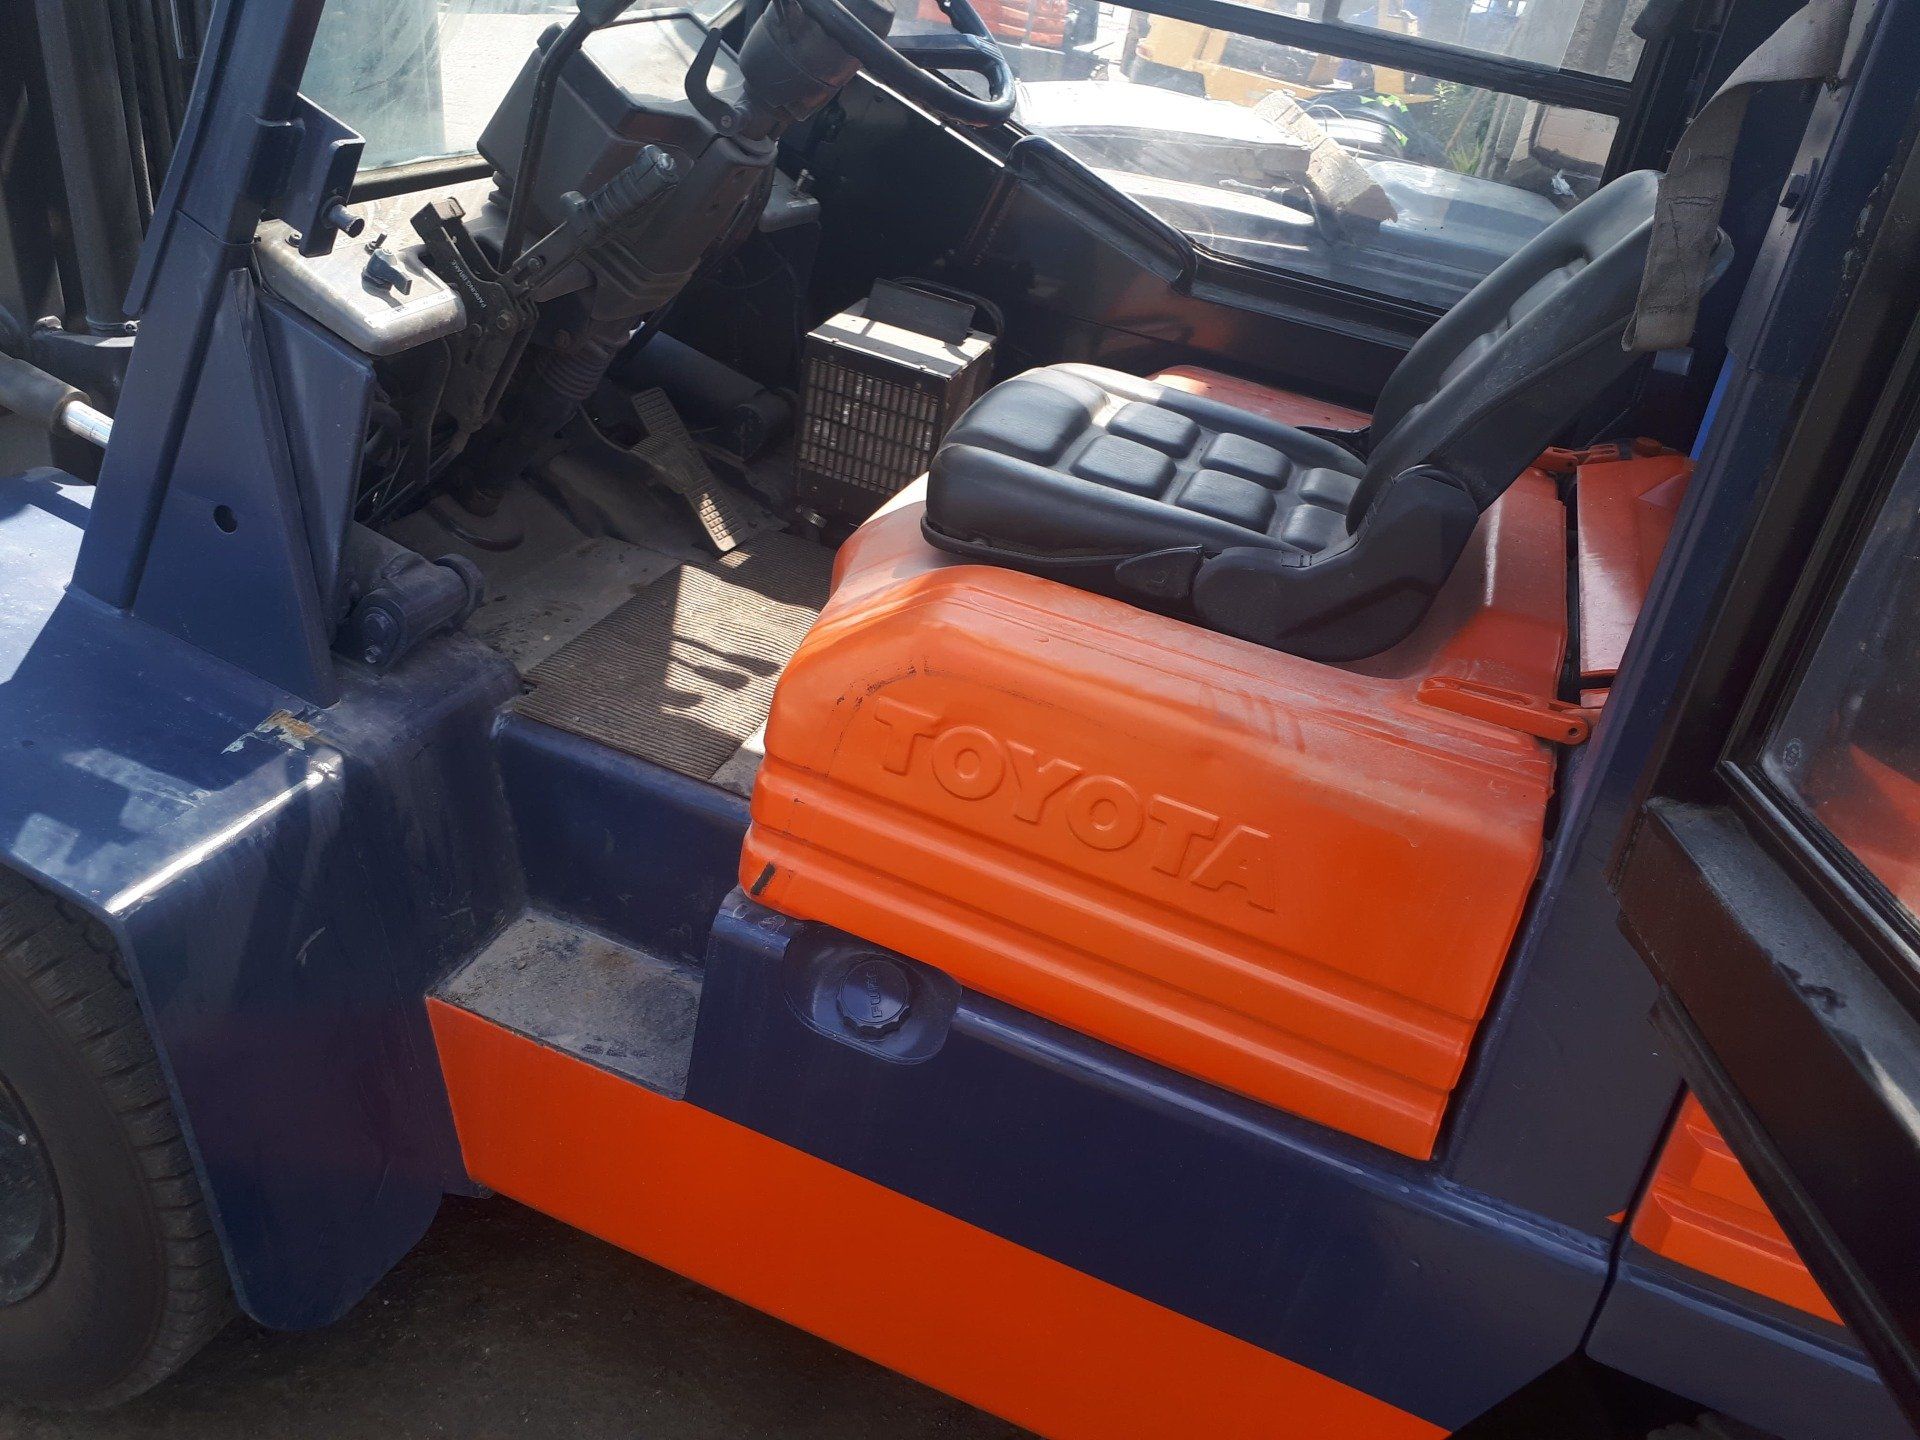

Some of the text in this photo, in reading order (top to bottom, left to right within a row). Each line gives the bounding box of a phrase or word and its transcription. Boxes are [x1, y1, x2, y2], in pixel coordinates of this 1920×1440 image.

[451, 259, 486, 309] PARKING BRAKE
[873, 696, 1274, 912] TOYOTA
